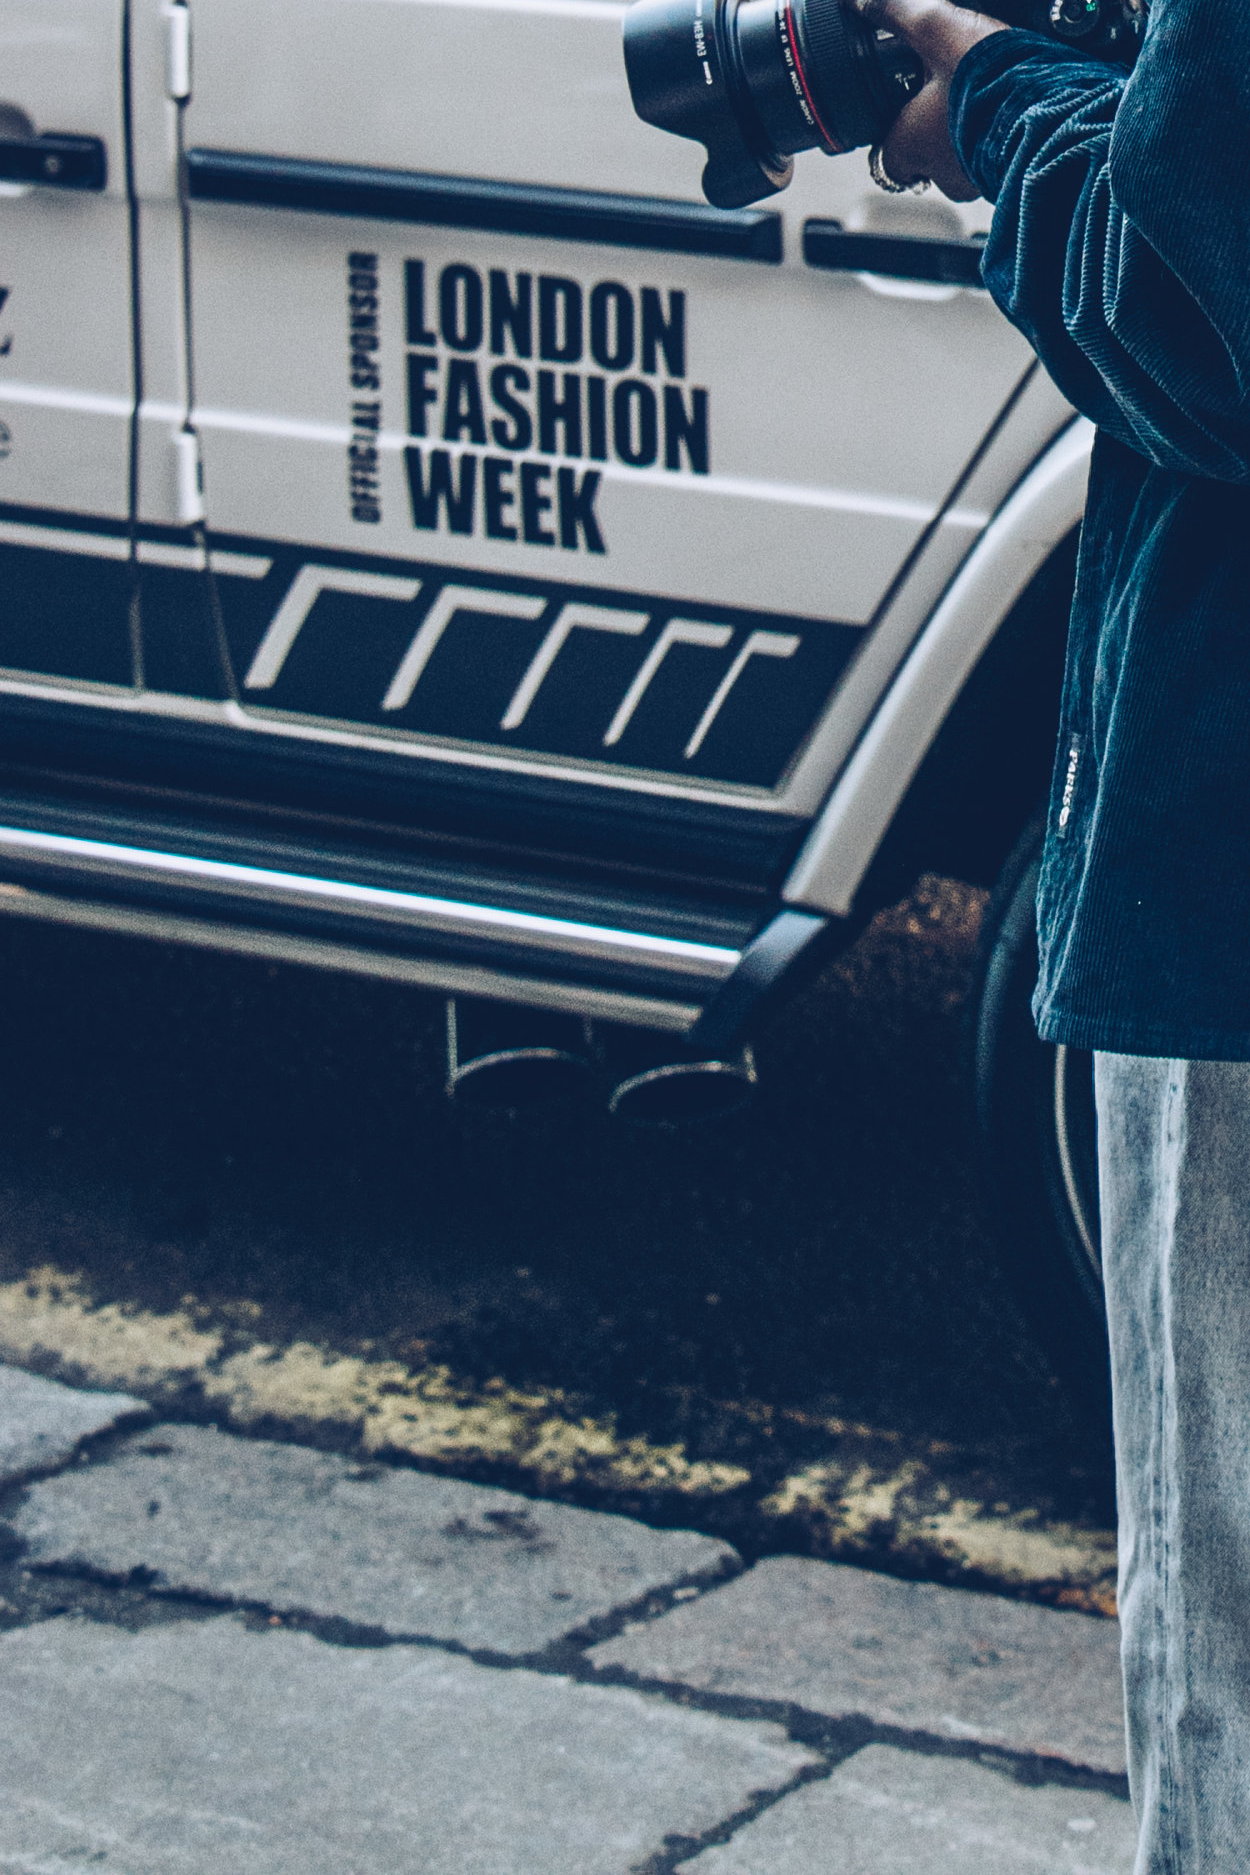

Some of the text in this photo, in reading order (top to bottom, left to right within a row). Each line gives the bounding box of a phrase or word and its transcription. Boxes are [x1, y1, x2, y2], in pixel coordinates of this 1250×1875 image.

[783, 47, 795, 67] LENS
[790, 71, 803, 96] ZOOM
[799, 99, 814, 125] CANON
[404, 258, 687, 379] LONDON
[347, 252, 382, 524] OFFICIAL SPONSOR
[405, 352, 710, 476] FASHION
[404, 445, 608, 555] WEEK
